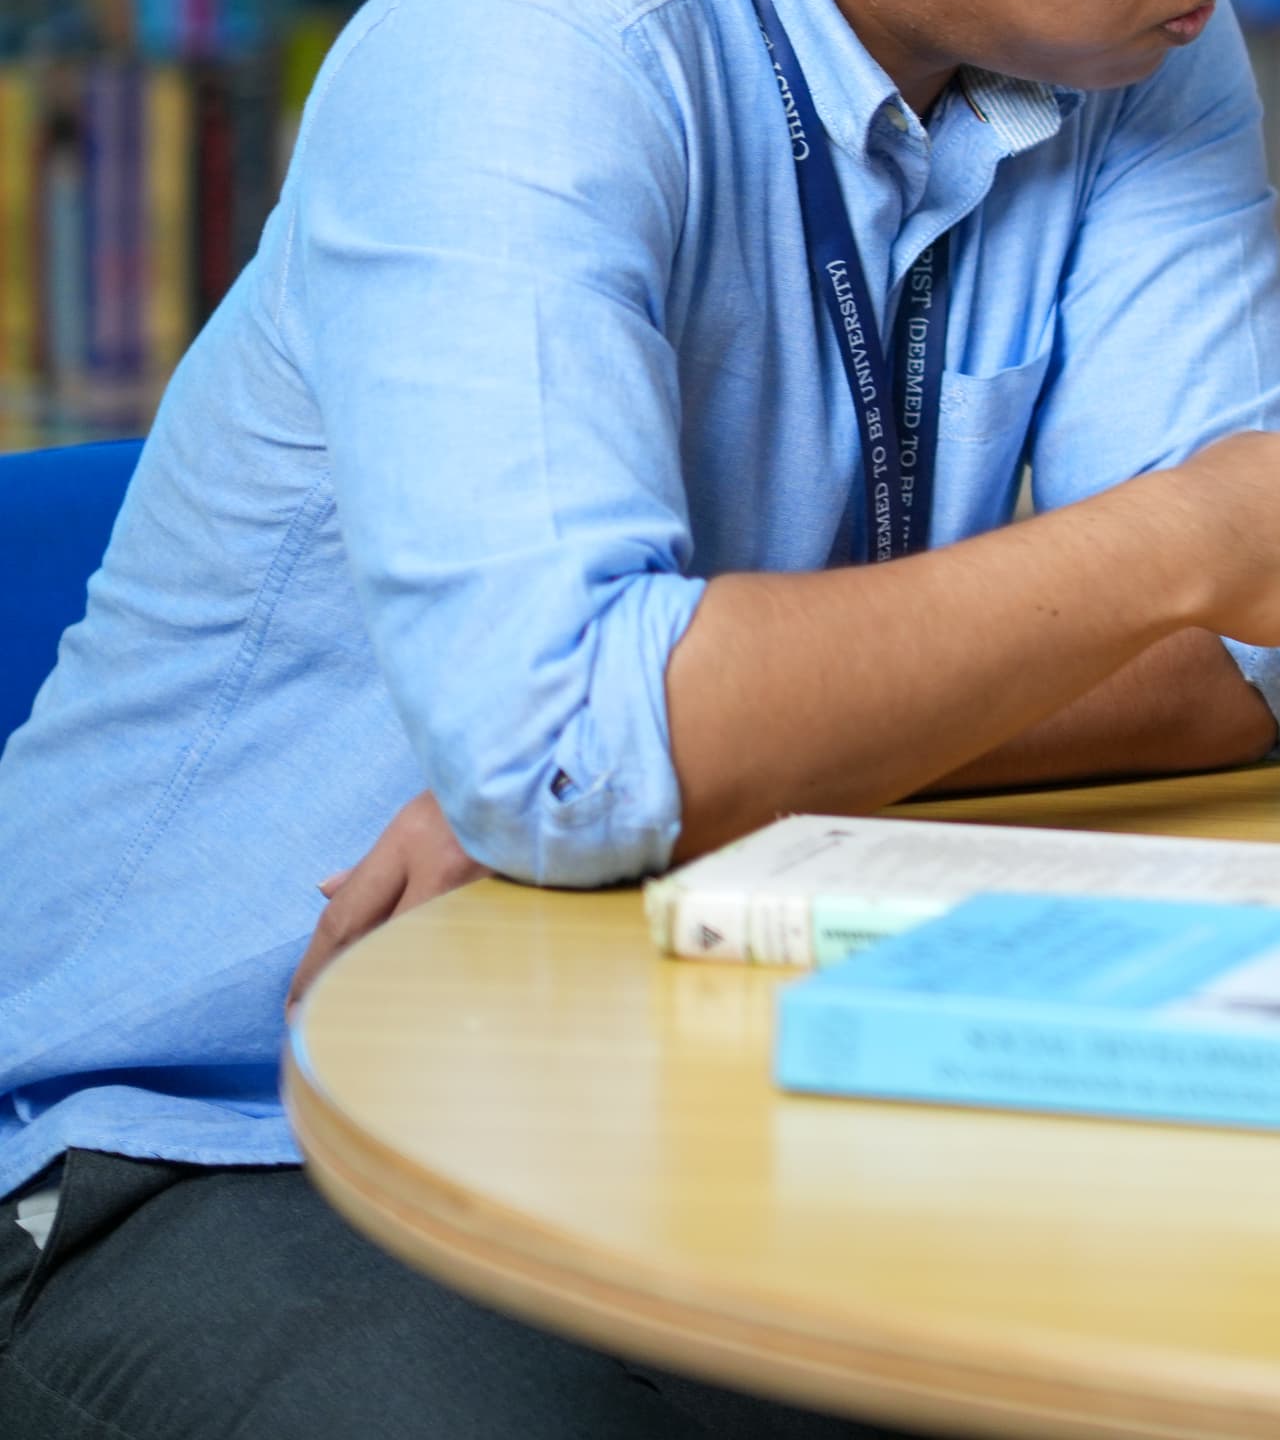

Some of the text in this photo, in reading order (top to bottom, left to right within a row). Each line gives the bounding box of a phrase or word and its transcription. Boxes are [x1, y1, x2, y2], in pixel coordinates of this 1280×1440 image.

[825, 259, 878, 405] UNIVERSITY)
[903, 317, 930, 429] (DEEMED
[865, 407, 884, 442] BE
[871, 446, 888, 480] TO
[900, 436, 920, 468] TO
